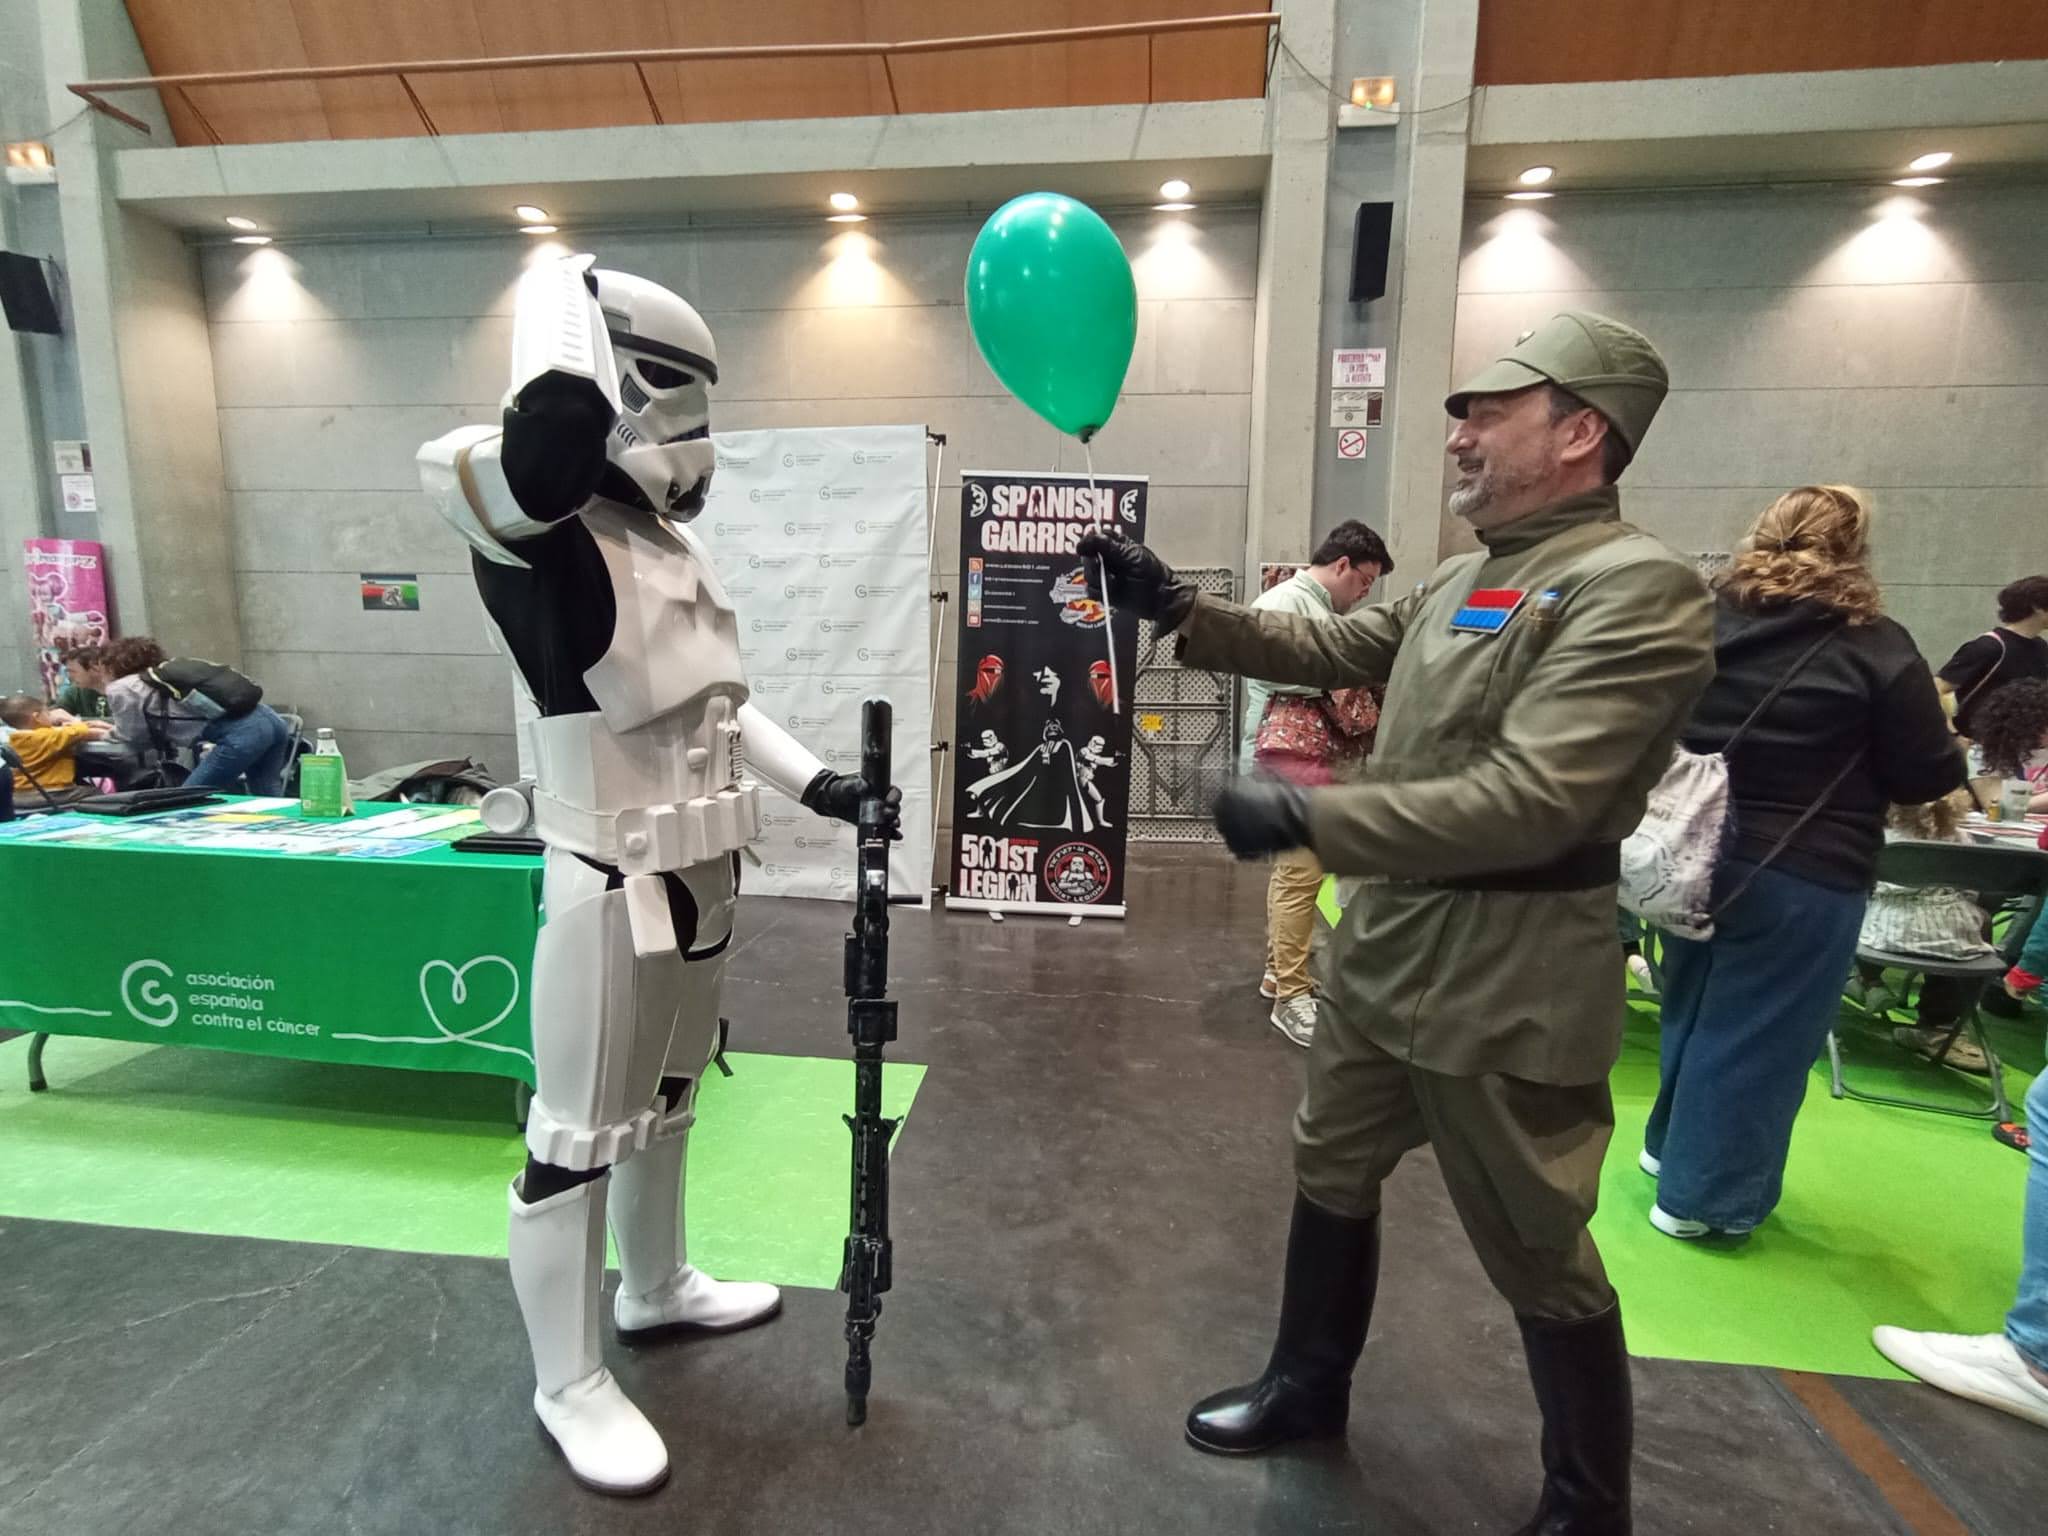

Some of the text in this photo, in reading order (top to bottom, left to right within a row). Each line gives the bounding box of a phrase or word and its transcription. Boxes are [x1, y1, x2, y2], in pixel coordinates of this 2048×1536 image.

[991, 484, 1115, 521] SPANISH
[980, 519, 1123, 556] GARRIS
[961, 833, 1039, 873] 501ST
[960, 868, 1038, 903] LEGION
[185, 971, 275, 991] asociación
[188, 993, 264, 1010] española
[192, 1013, 320, 1036] contra el cáncer
